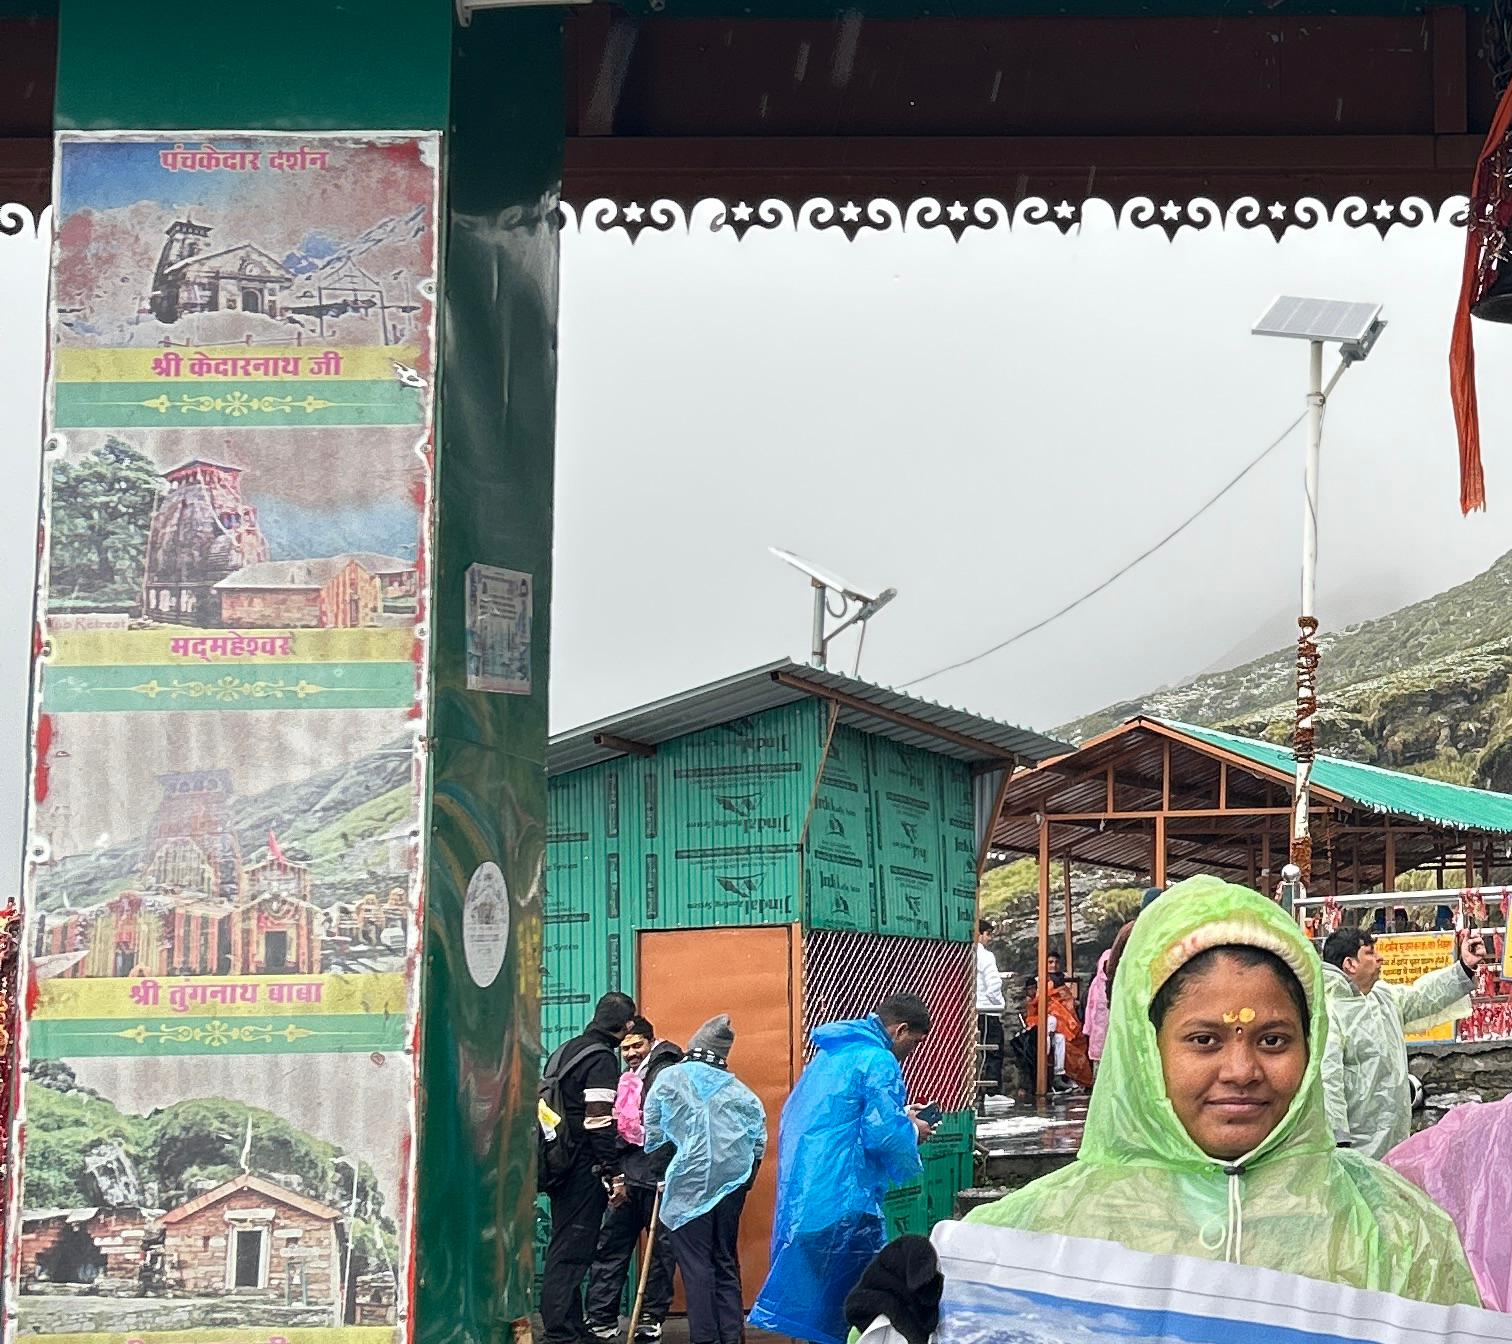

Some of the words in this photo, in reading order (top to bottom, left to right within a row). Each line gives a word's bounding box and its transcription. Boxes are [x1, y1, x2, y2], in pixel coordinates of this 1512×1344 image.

[160, 144, 262, 171] पंचकेदार
[268, 146, 330, 171] दर्शन
[152, 352, 184, 377] श्री
[188, 351, 302, 377] केदारनाथ
[308, 351, 343, 376] जी
[129, 979, 160, 1006] श्री
[168, 978, 259, 1013] तुंगनाथ
[267, 983, 324, 1004] बाबा
